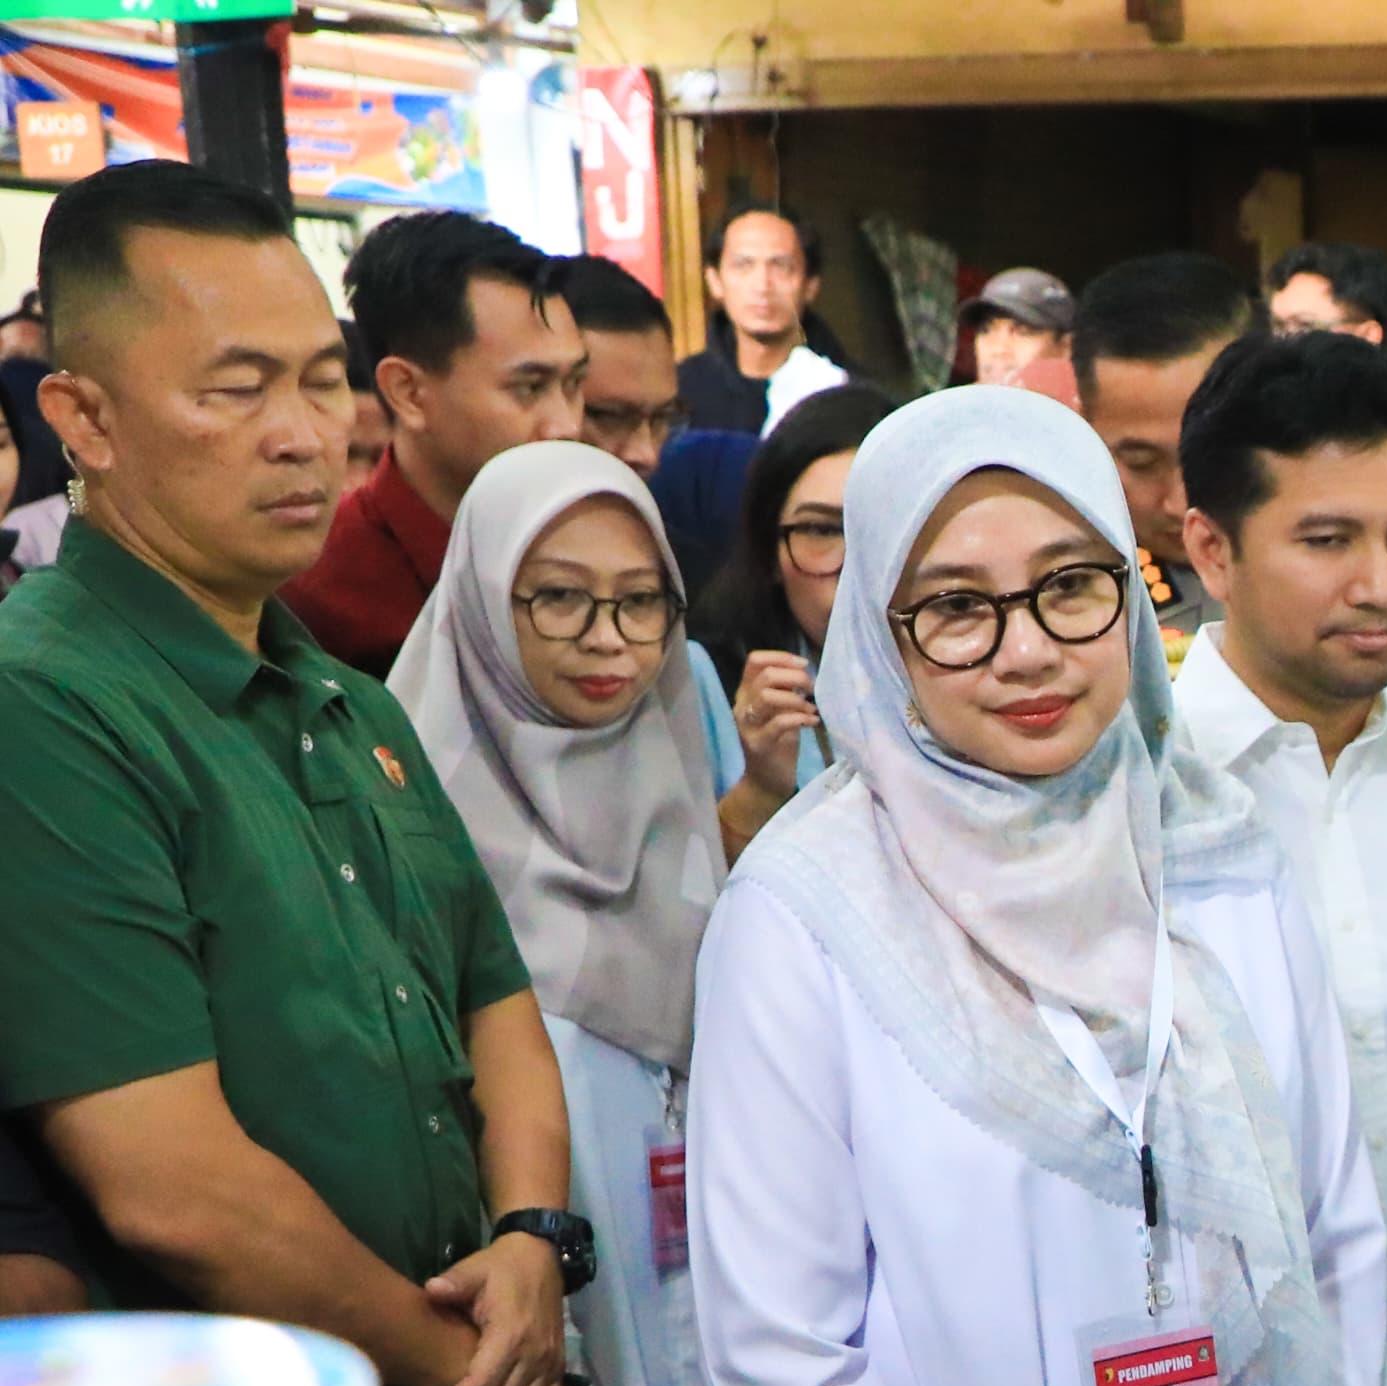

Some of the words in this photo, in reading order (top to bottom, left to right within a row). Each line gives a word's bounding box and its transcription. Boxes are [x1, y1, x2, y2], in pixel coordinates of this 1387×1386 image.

[28, 112, 88, 137] KIOS
[49, 142, 74, 165] 17
[1117, 1355, 1193, 1383] PENDAMPING
